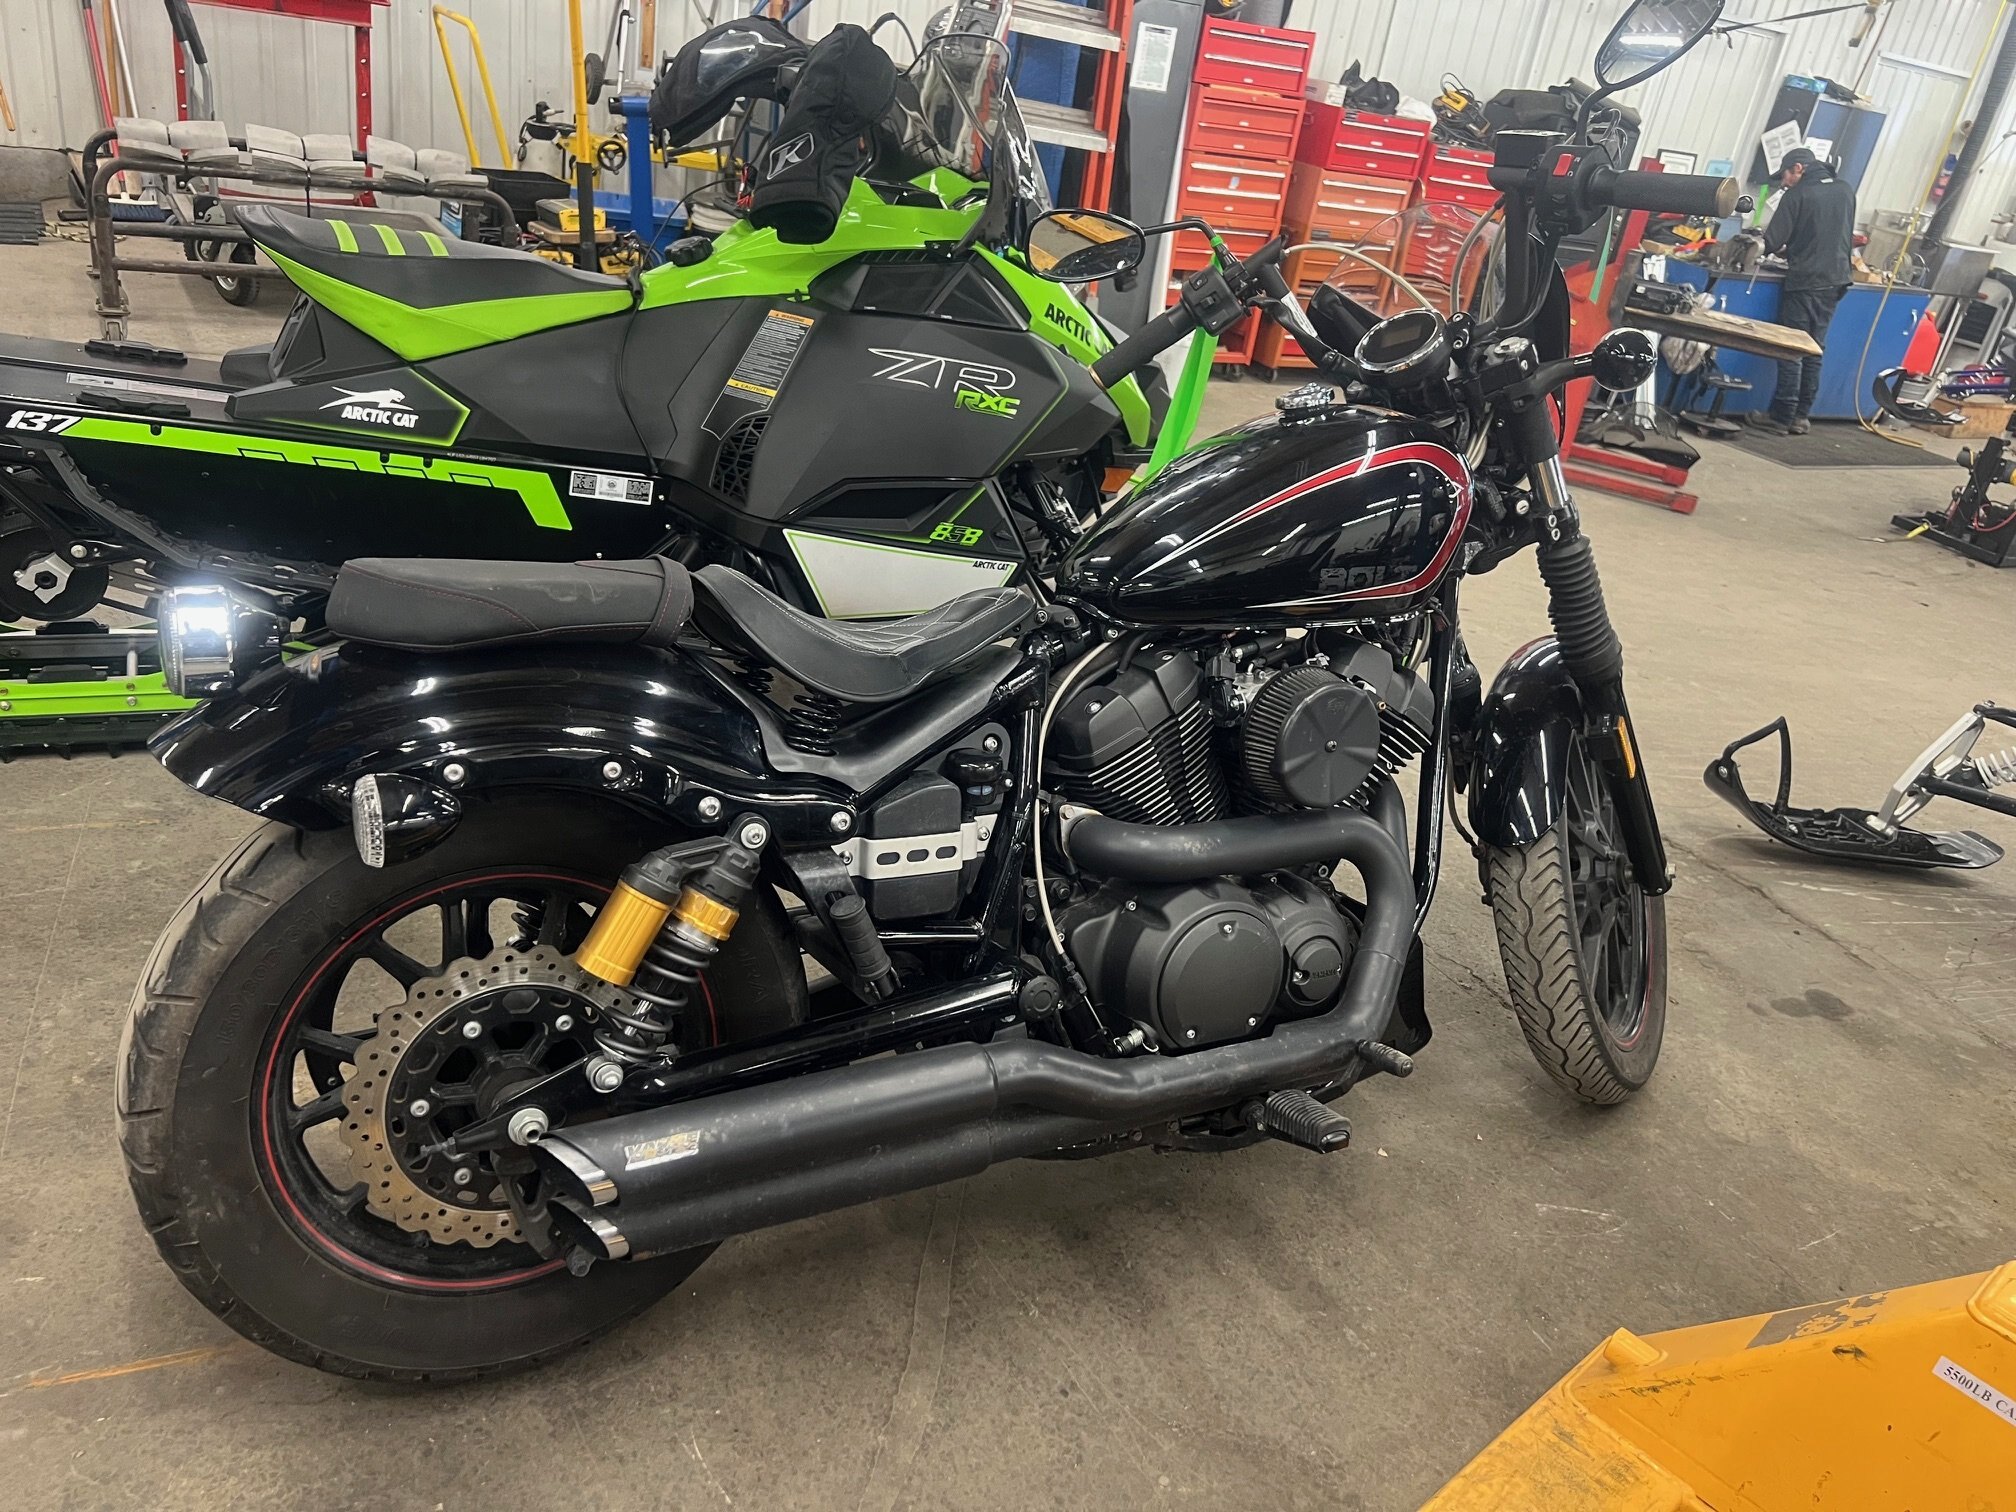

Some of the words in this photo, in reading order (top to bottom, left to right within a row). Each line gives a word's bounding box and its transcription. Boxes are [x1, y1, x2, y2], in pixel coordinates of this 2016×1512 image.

[1044, 303, 1091, 347] ARCTIC
[741, 382, 767, 394] CAUTION
[954, 389, 1020, 418] RXC
[5, 410, 82, 433] 137
[341, 405, 392, 424] ARCTIC
[392, 413, 419, 428] CAT
[929, 522, 983, 546] 858
[973, 561, 996, 570] ARCTIC
[1943, 1366, 1992, 1402] 5500LB
[1995, 1399, 2016, 1420] CA
